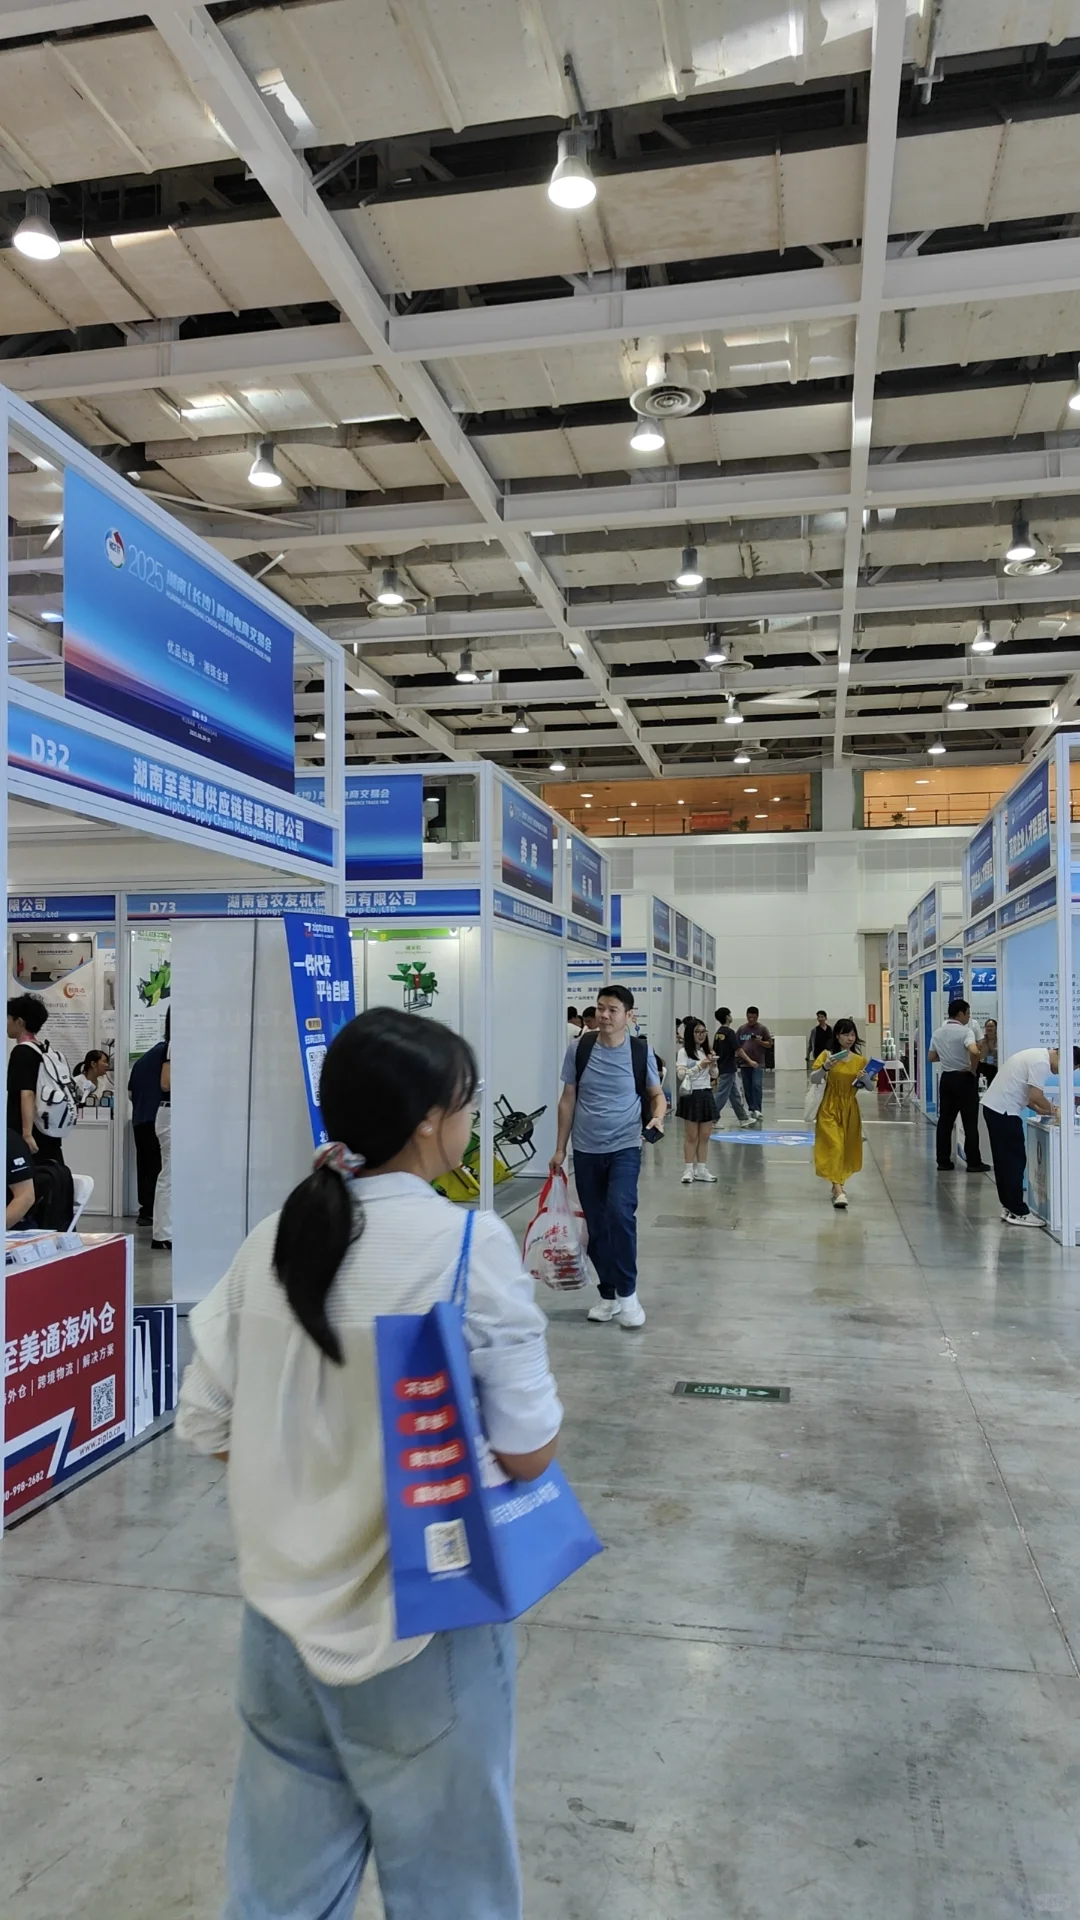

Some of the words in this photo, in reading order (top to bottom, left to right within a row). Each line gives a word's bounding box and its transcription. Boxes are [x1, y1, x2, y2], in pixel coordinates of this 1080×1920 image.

[128, 544, 164, 593] 2025
[31, 733, 70, 772] D32
[133, 757, 304, 843] 湖南至美通供应链管理有限公司
[133, 786, 163, 808] Hunan
[164, 795, 185, 815] Zipto
[186, 804, 212, 826] Supply
[213, 813, 234, 829] Chain
[234, 819, 276, 845] Management
[8, 898, 46, 912] 限公司
[150, 902, 176, 913] D73
[228, 908, 254, 916] Hunan
[293, 954, 332, 977] 一件代发
[316, 980, 350, 1002] 平台自提
[4, 1301, 116, 1378] 至美通海外仓
[4, 1385, 27, 1406] 外仓
[37, 1362, 74, 1390] 跨境物流
[82, 1343, 115, 1369] 解决方案
[79, 1426, 121, 1457] www.zipto.cn
